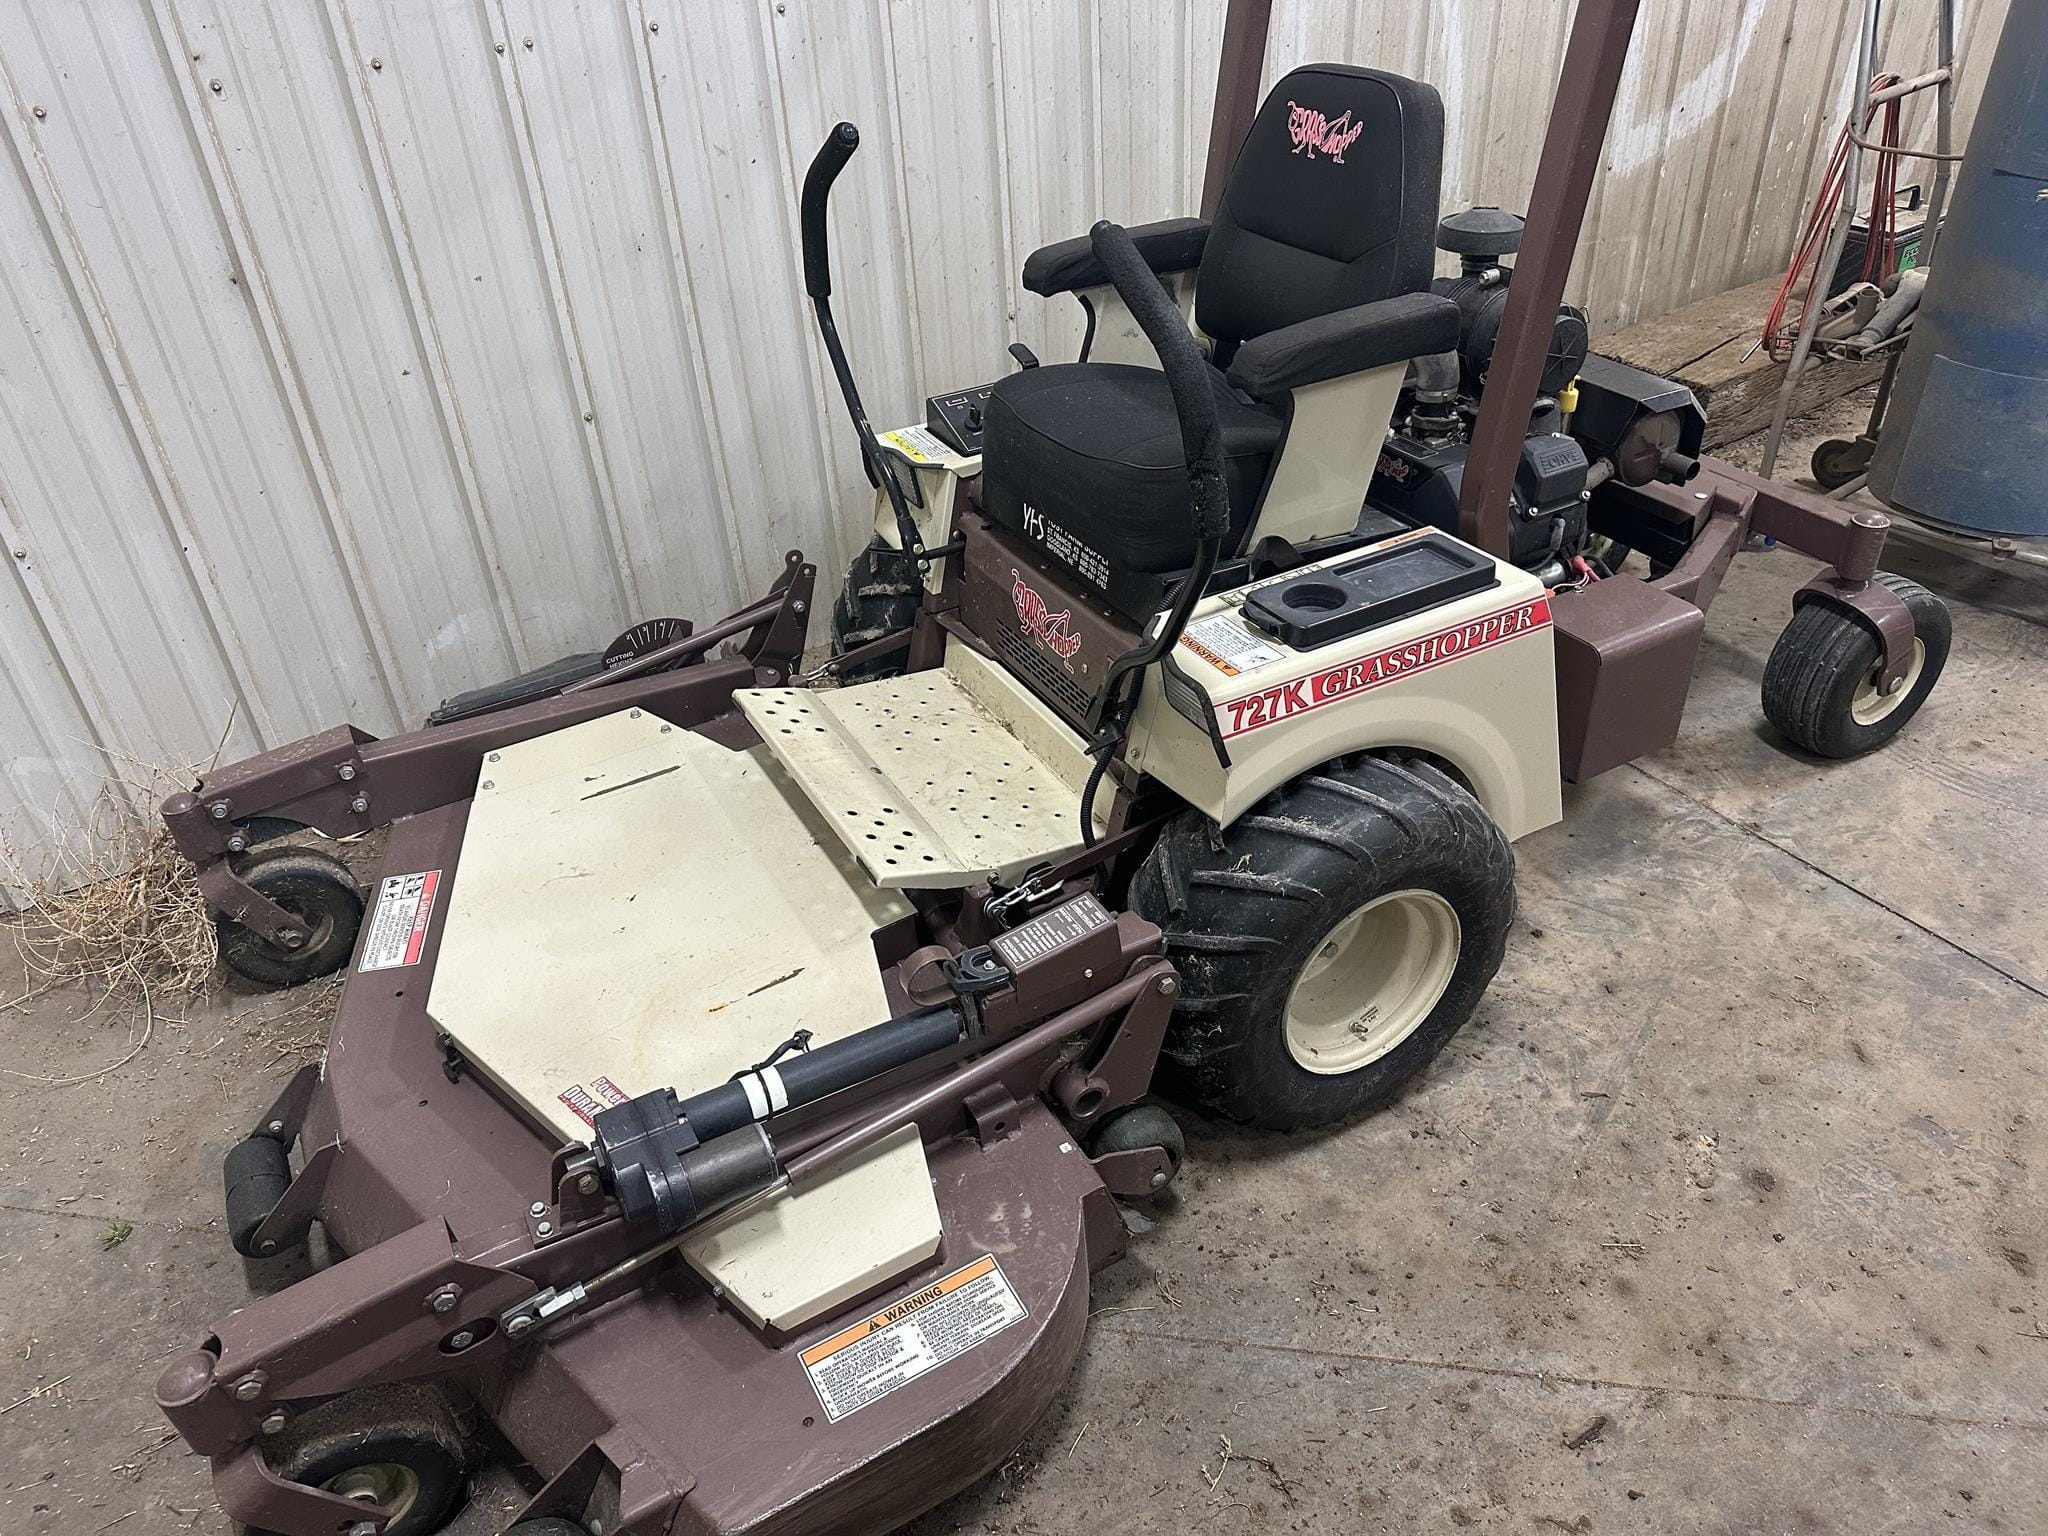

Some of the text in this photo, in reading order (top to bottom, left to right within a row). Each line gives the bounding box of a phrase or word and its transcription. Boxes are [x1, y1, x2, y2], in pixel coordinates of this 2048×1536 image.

[606, 651, 634, 665] CUTTING
[1227, 678, 1309, 732] 727K
[1320, 604, 1535, 698] GRASSHOPPER
[413, 900, 430, 932] DANGER
[883, 1285, 943, 1322] WARNING
